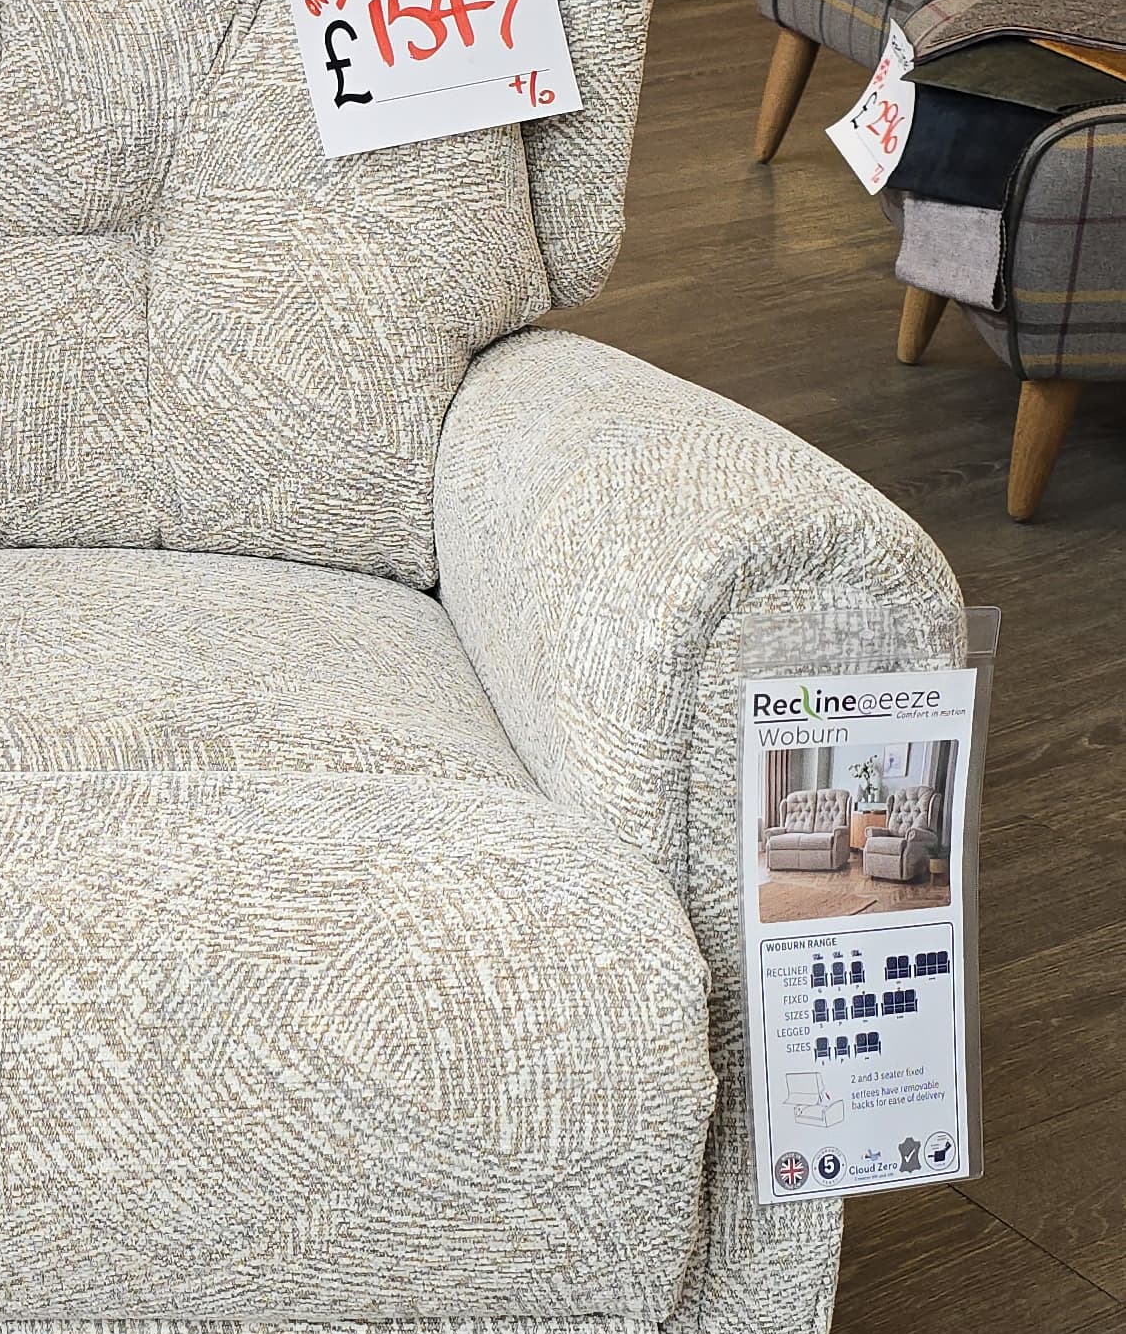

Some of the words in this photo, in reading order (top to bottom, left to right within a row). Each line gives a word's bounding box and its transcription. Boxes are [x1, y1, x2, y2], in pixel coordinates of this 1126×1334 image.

[896, 709, 930, 719] Comfort
[758, 725, 849, 748] Woburn
[766, 940, 806, 952] WOBURN
[807, 937, 838, 948] RANGE
[766, 965, 808, 978] RECLINER
[783, 976, 808, 987] SIZES
[783, 994, 809, 1005] FIXED
[784, 1010, 810, 1021] SIZES
[777, 1026, 811, 1038] LEGGED
[786, 1042, 811, 1053] SIZES
[850, 1074, 856, 1083] 2
[857, 1072, 873, 1083] and
[874, 1071, 879, 1081] 3
[880, 1069, 905, 1080] seater
[906, 1066, 924, 1077] fixed
[881, 1086, 899, 1097] have
[900, 1080, 940, 1093] removable
[851, 1100, 875, 1111] backs
[876, 1098, 887, 1108] for
[915, 1090, 946, 1101] delivery
[824, 1155, 835, 1174] 5
[848, 1163, 876, 1175] Cloud
[877, 1161, 898, 1172] Zero
